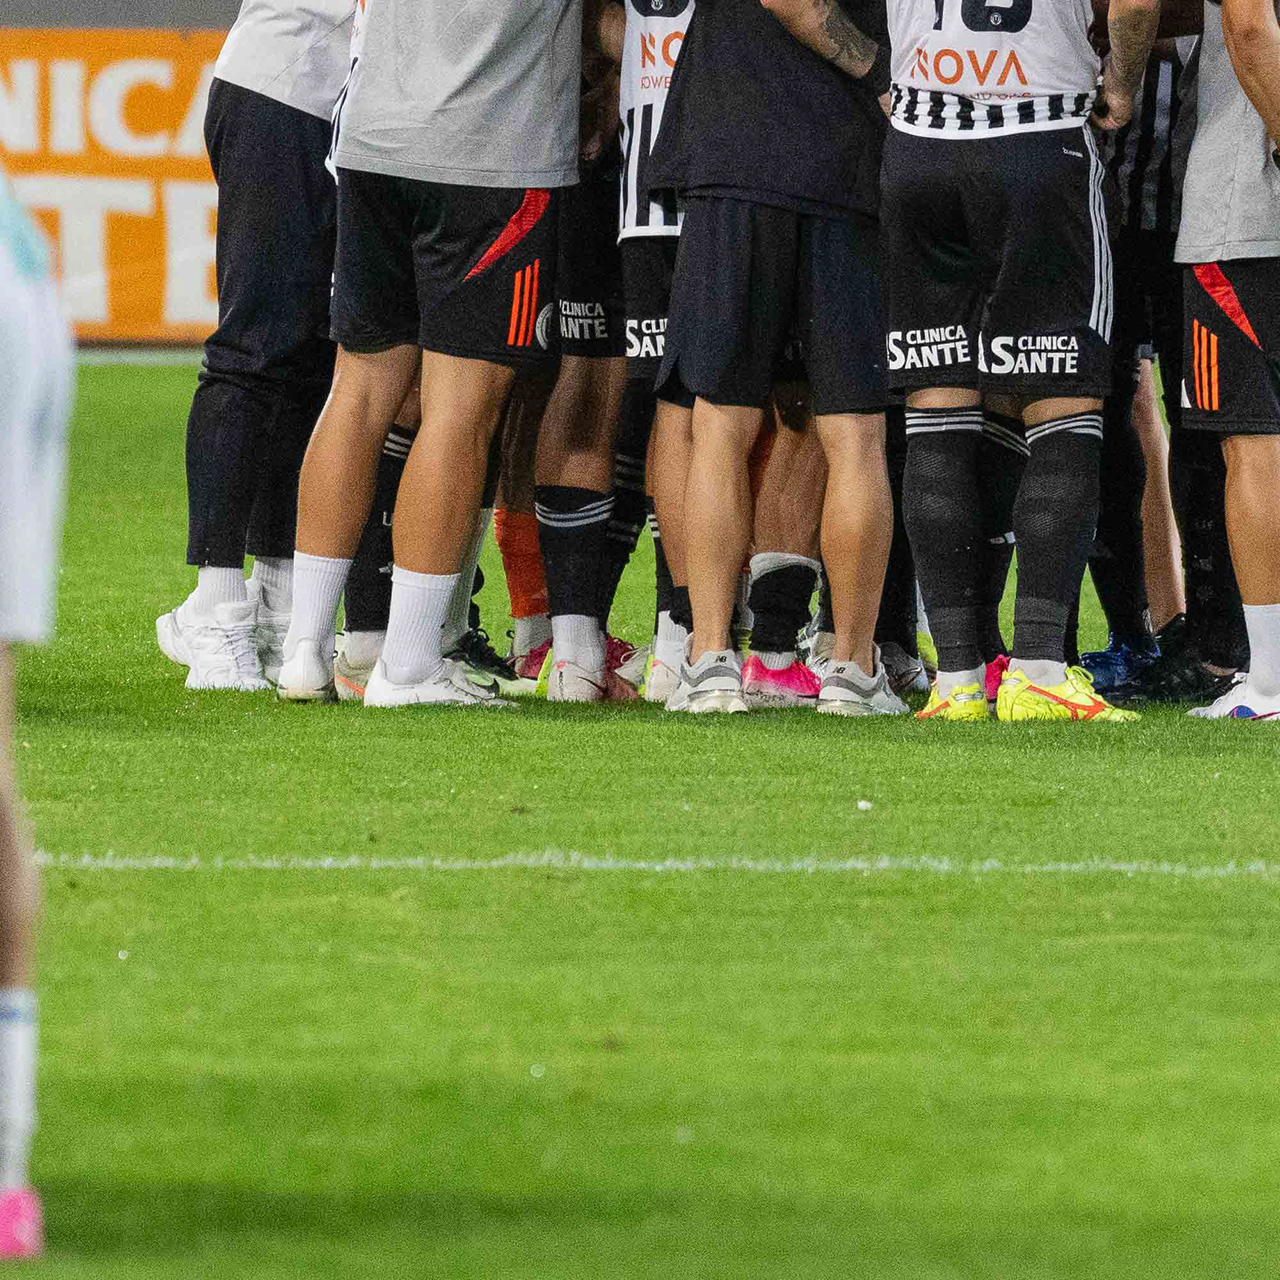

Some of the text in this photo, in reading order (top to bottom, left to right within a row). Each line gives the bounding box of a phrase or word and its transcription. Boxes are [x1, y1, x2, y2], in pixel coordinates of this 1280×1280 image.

[910, 47, 1028, 86] NOVA
[888, 330, 971, 370] SANTE
[906, 325, 967, 345] CLINICA
[1018, 336, 1079, 350] CLINICA
[991, 336, 1079, 374] SANTE
